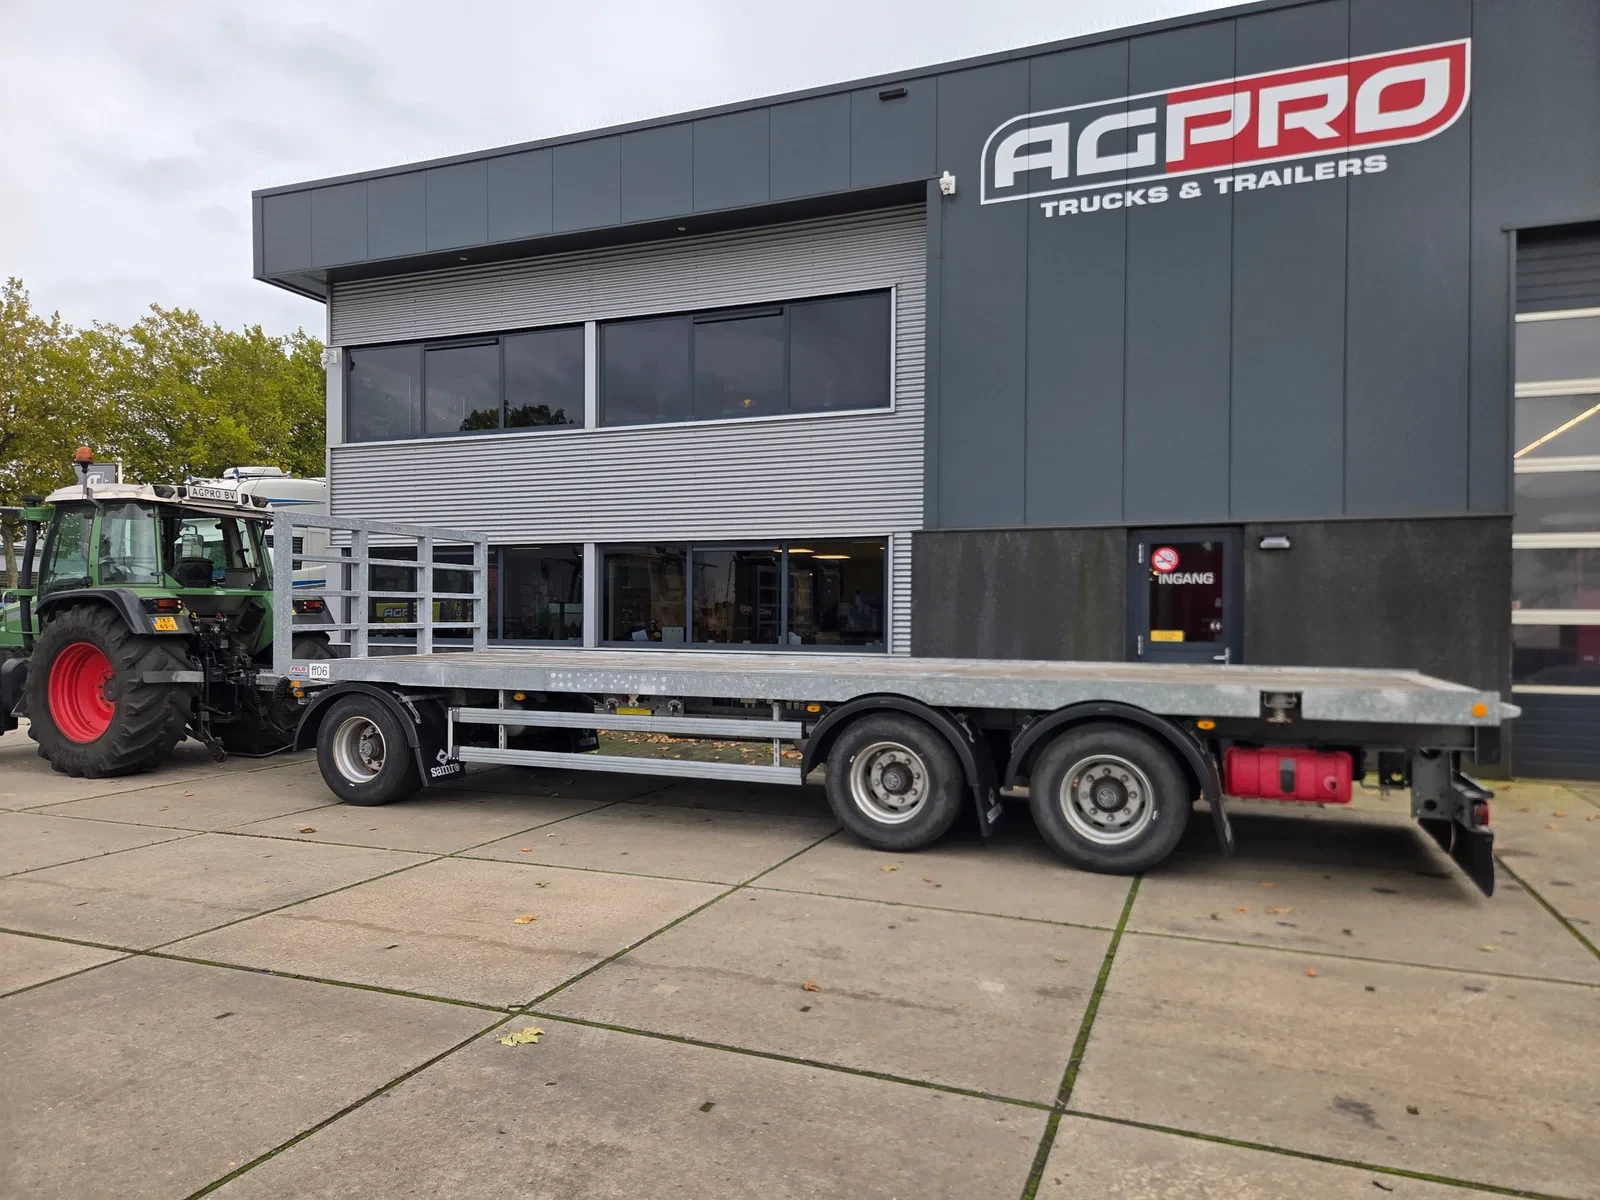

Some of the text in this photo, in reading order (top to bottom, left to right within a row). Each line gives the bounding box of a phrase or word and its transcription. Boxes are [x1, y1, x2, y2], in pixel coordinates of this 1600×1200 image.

[994, 57, 1451, 189] AGPRO
[1040, 154, 1389, 218] TRUCKS & TRAILERS
[192, 488, 235, 500] AGPRO BV
[1158, 571, 1216, 585] INGANG
[311, 665, 328, 677] ff06
[430, 762, 461, 778] samro
